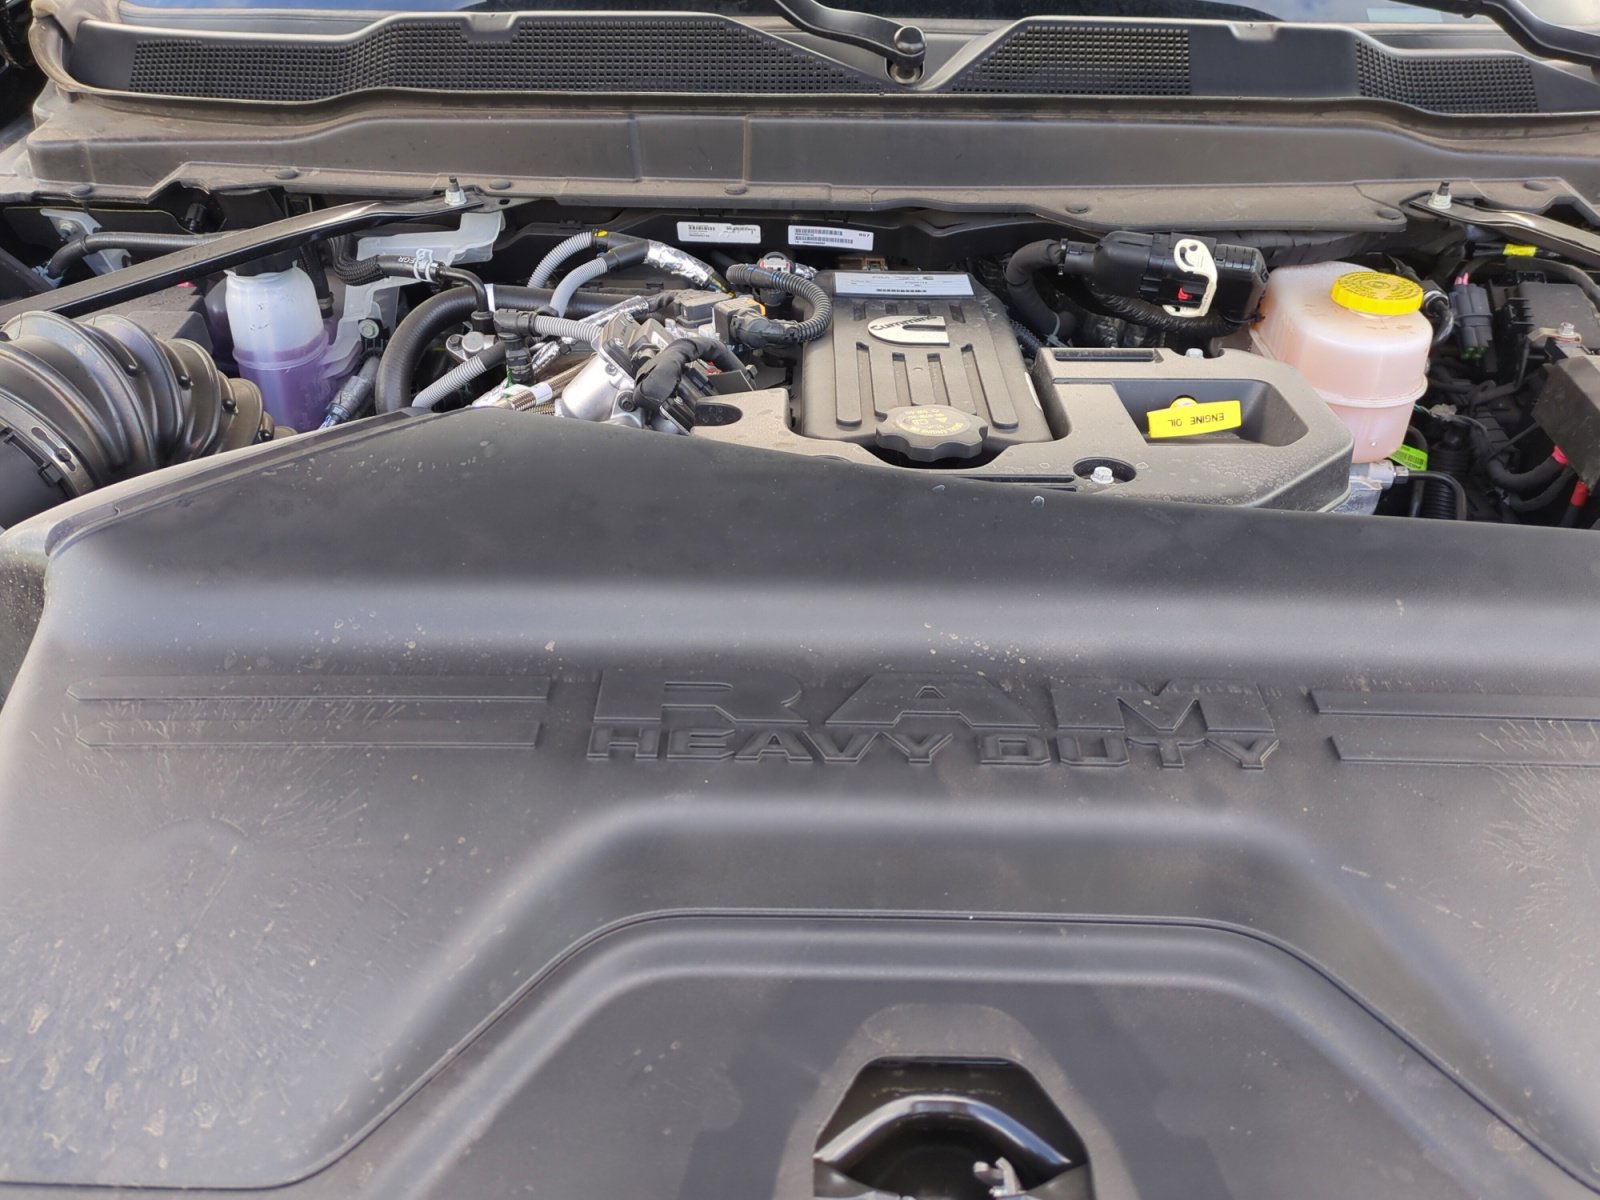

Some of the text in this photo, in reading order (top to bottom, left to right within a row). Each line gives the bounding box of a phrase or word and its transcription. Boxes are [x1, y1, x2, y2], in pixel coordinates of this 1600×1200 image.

[398, 256, 417, 264] EGR
[870, 315, 938, 331] Cummins
[1168, 412, 1225, 427] ENGINE OIL
[593, 669, 1277, 732] RAM
[586, 726, 1280, 770] HEAVY DUTY
